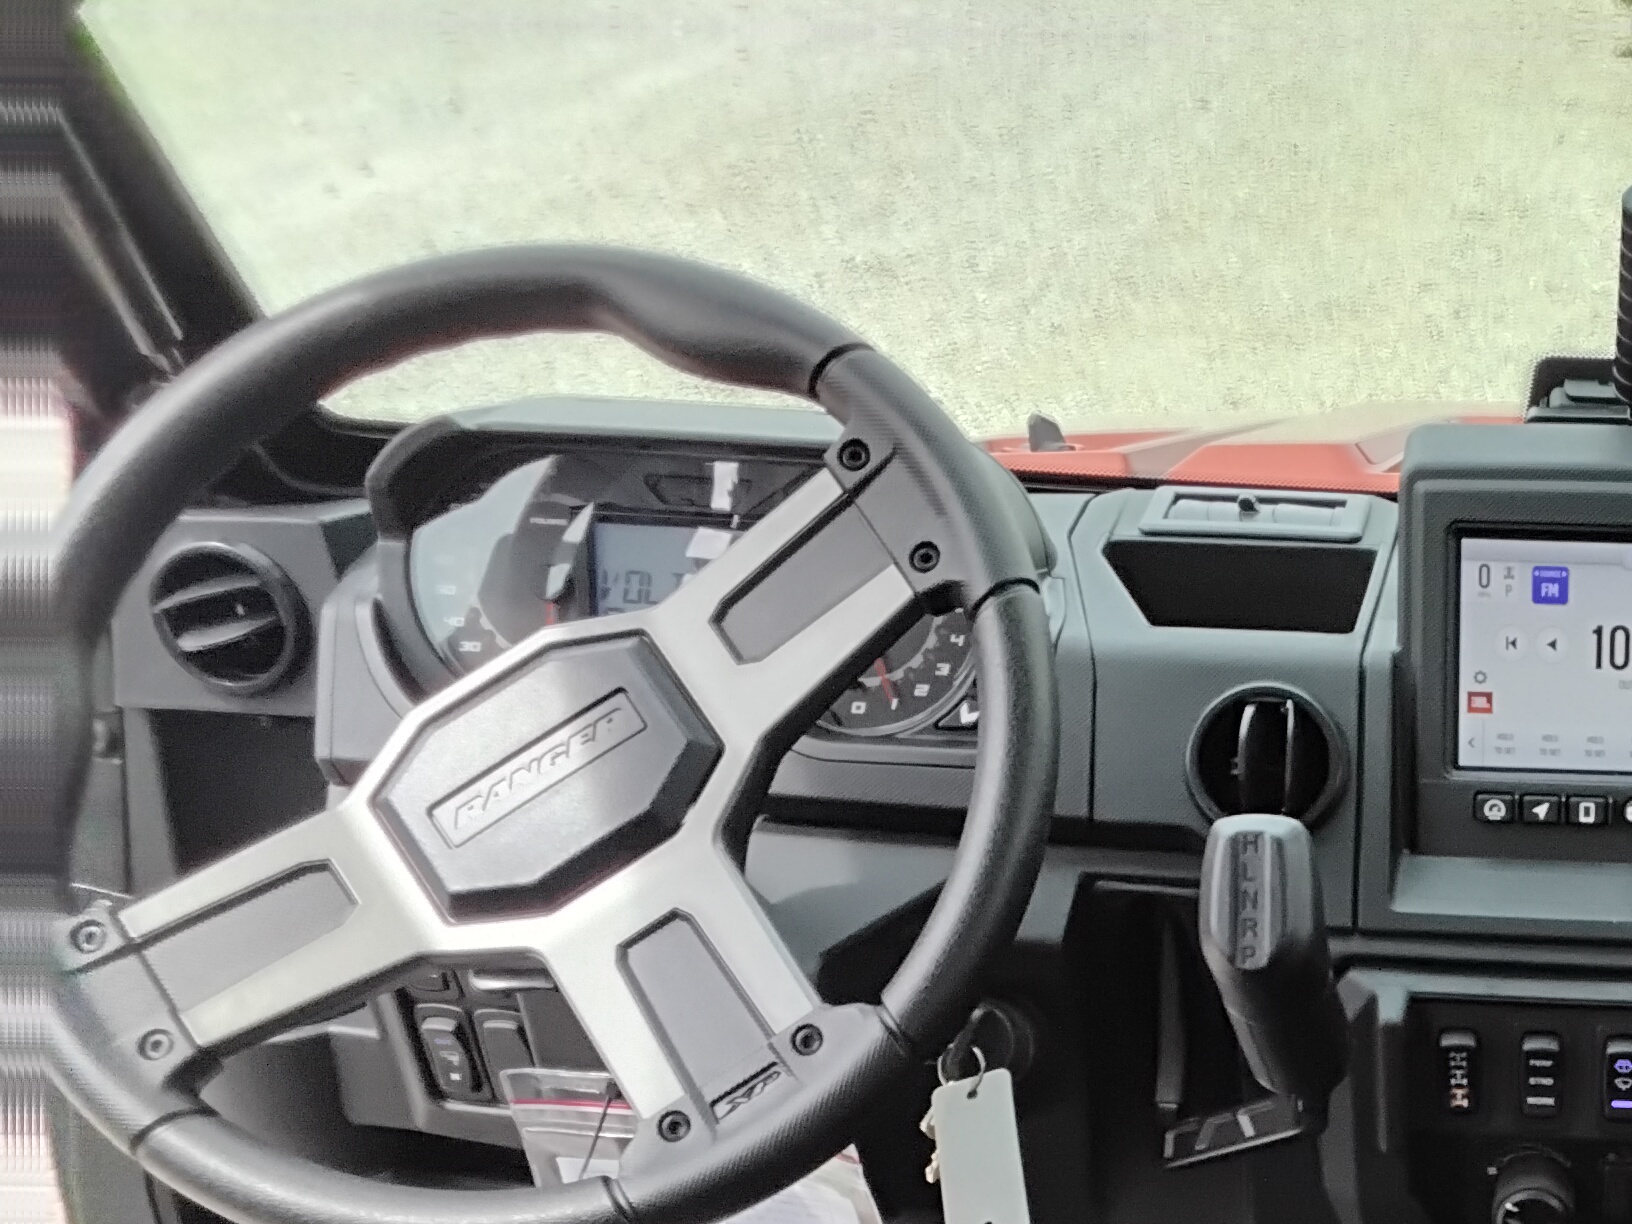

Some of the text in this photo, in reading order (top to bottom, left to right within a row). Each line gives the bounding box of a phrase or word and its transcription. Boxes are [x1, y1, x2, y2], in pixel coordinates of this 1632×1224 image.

[1478, 563, 1491, 589] 0
[1541, 583, 1560, 598] FM
[458, 641, 482, 652] 30
[950, 634, 966, 647] 4
[934, 662, 951, 676] 3
[913, 683, 931, 697] 2
[850, 701, 867, 715] 0
[453, 704, 632, 833] RANGER
[1240, 832, 1259, 855] H
[1240, 860, 1256, 882] L
[1240, 888, 1259, 912] N
[1240, 918, 1258, 938] R
[1240, 945, 1257, 965] P
